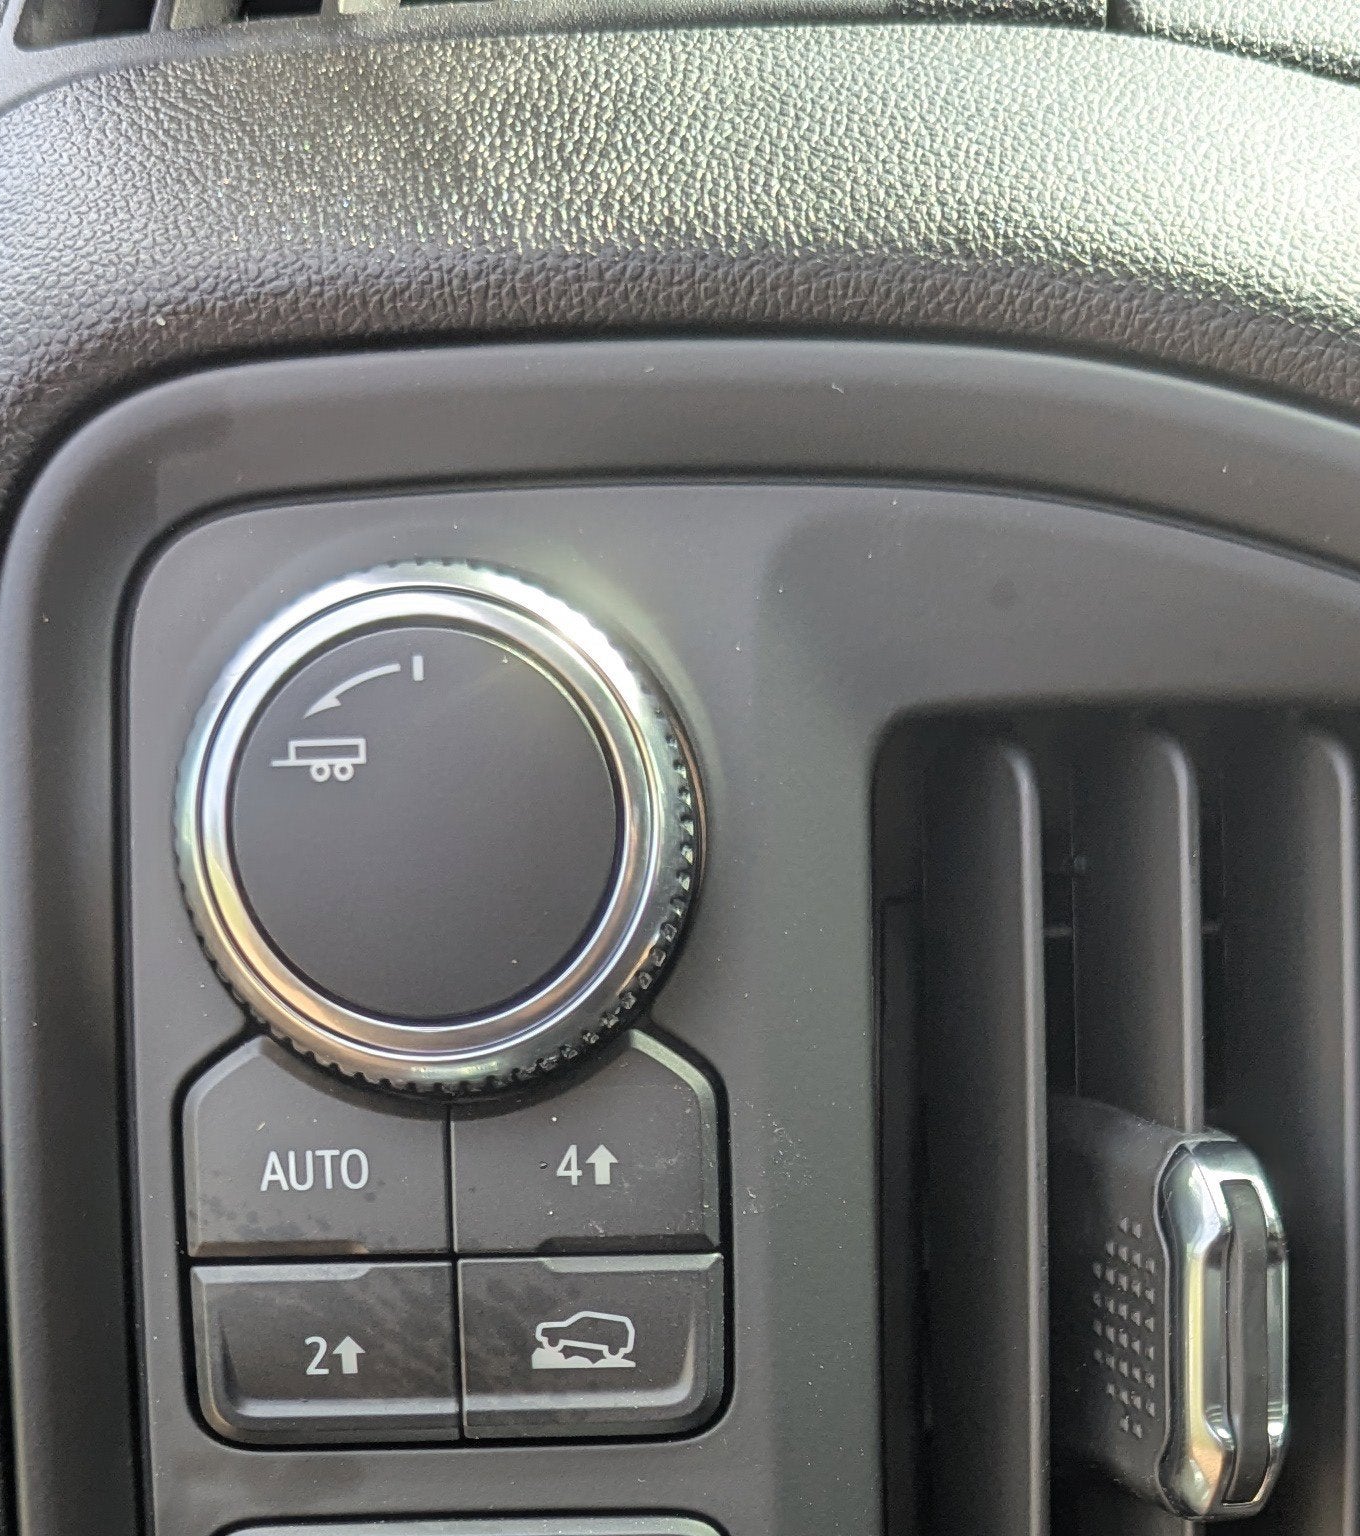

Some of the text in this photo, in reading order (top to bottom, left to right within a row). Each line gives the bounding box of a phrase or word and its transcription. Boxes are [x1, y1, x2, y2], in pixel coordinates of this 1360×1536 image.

[260, 1147, 370, 1192] AUTO
[556, 1144, 583, 1186] 4
[304, 1336, 330, 1376] 2
